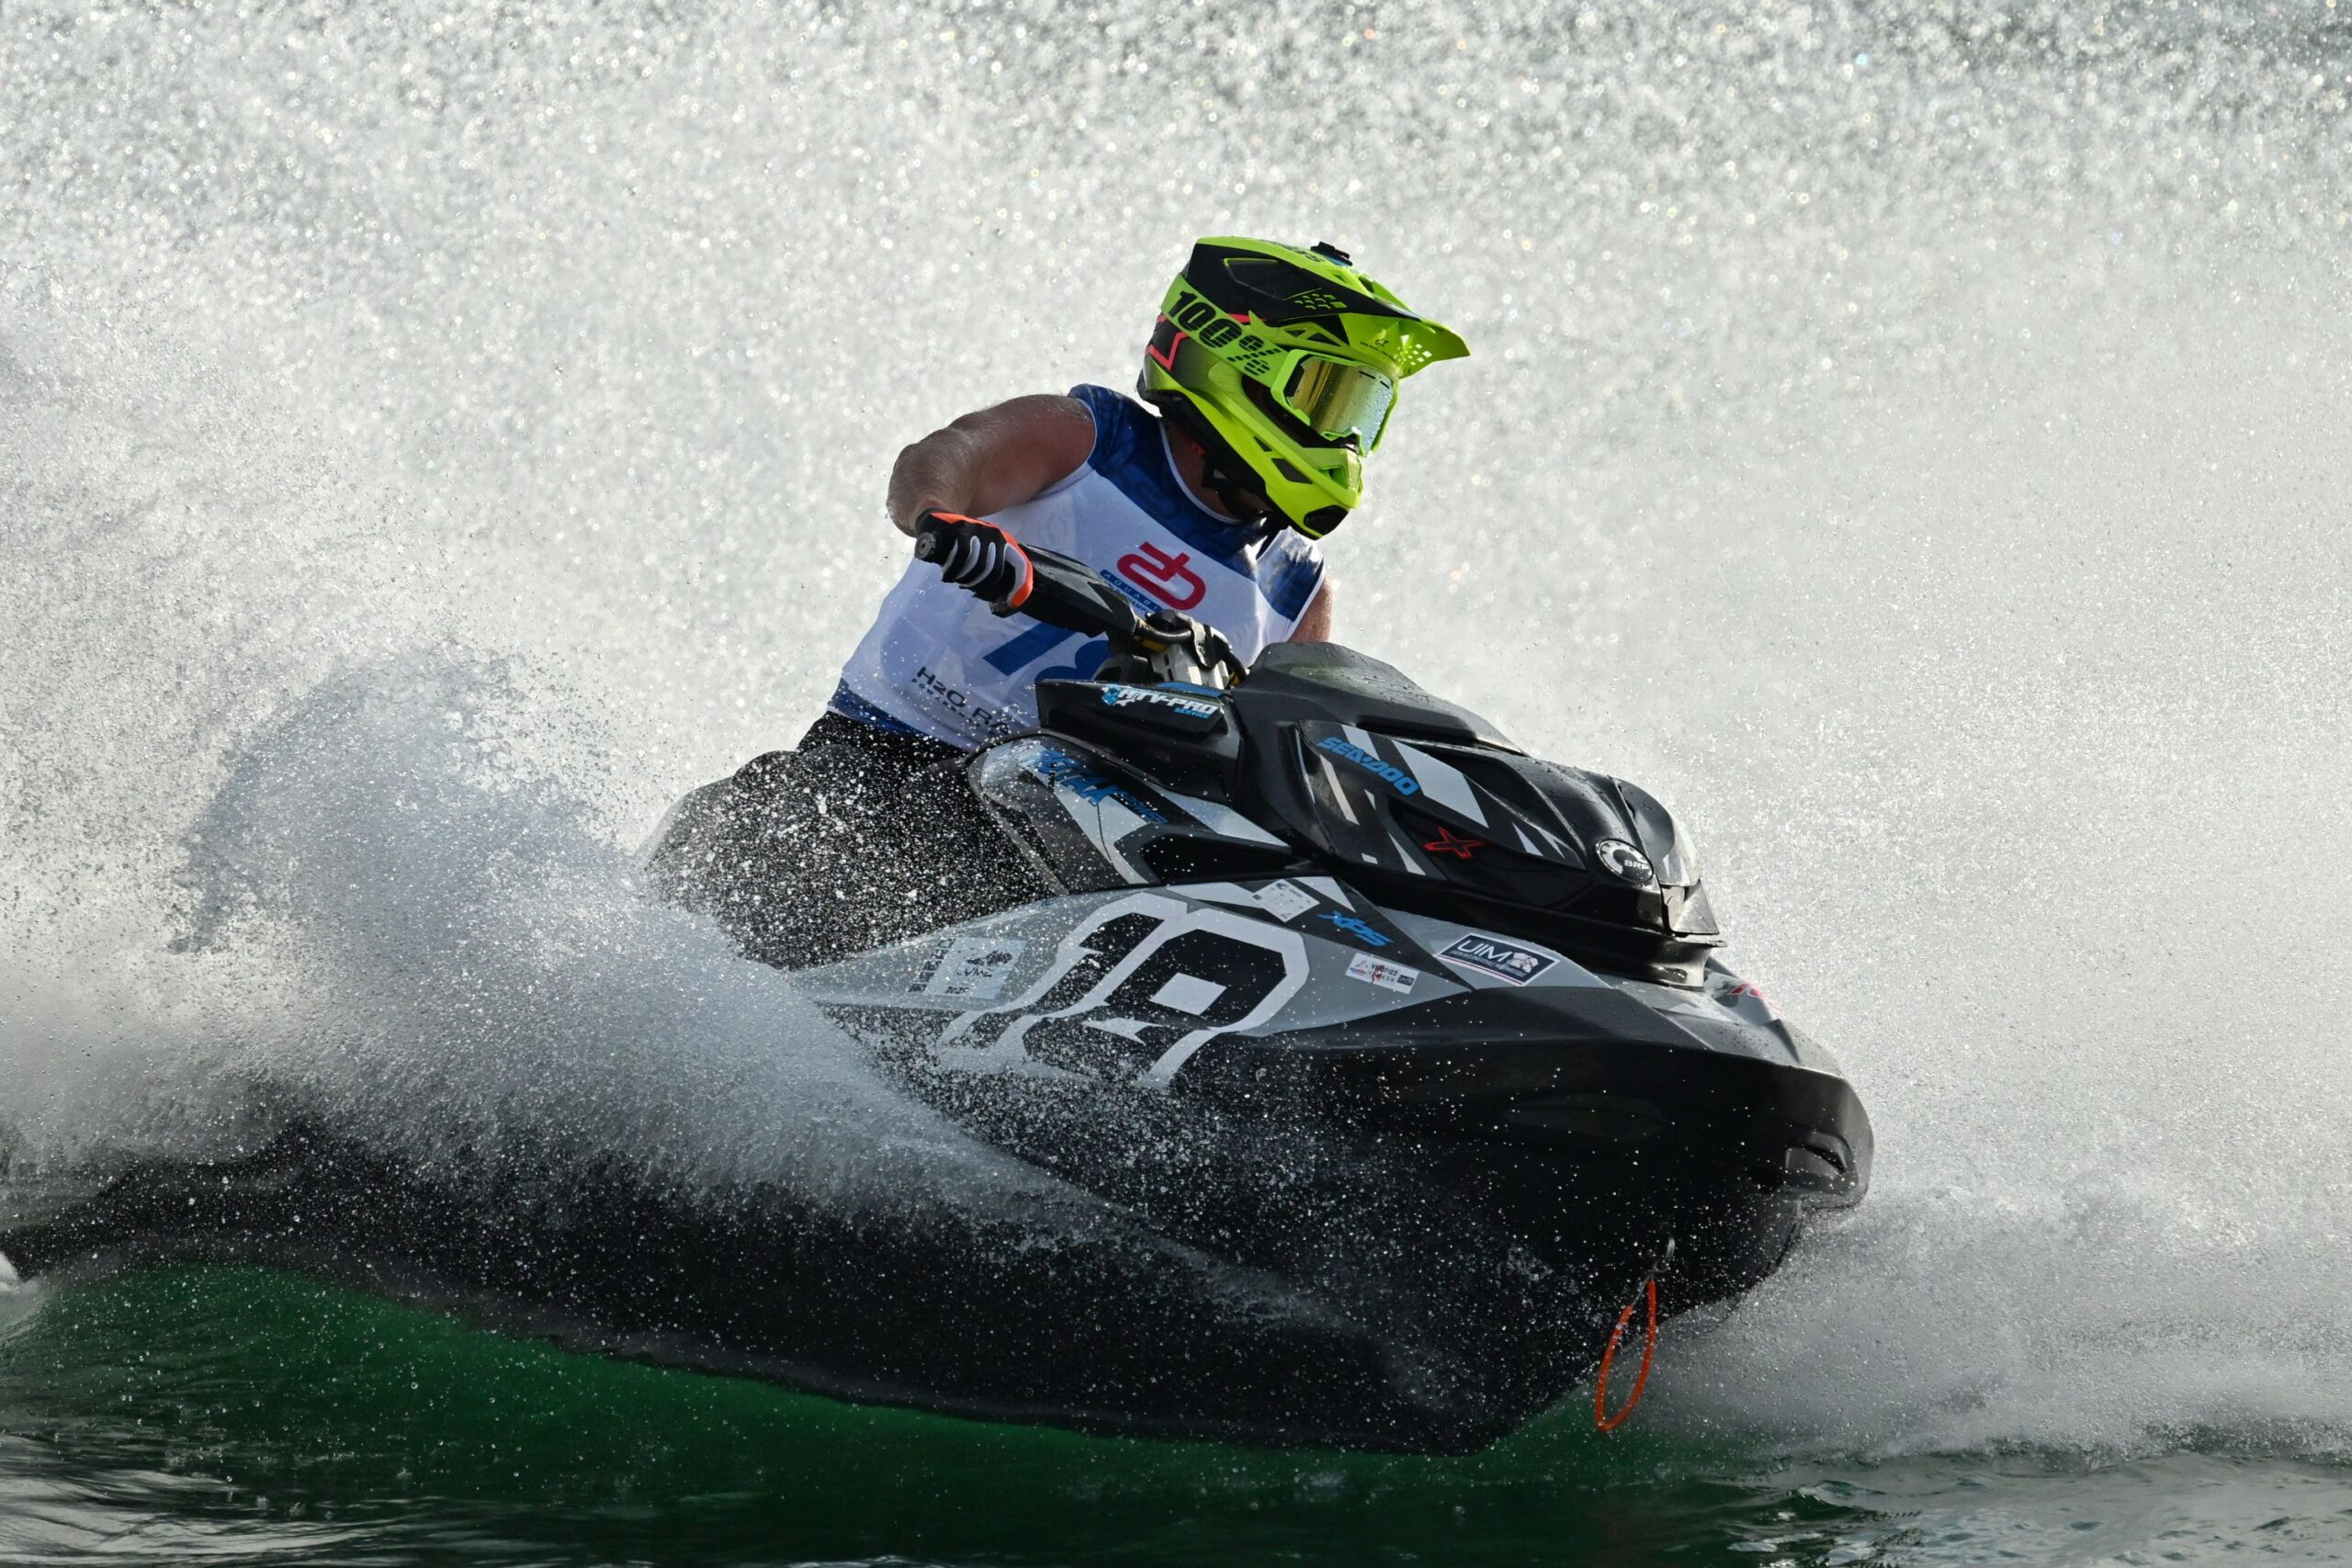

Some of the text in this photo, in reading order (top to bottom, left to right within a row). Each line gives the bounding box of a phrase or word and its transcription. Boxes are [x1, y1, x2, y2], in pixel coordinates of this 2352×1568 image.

[1167, 290, 1286, 378] 100%
[1103, 572, 1159, 611] AQUABI
[916, 666, 1010, 736] H2O RA
[1117, 689, 1219, 715] ATV-PRO
[1456, 940, 1513, 963] UIM
[1371, 963, 1398, 976] VEFIED
